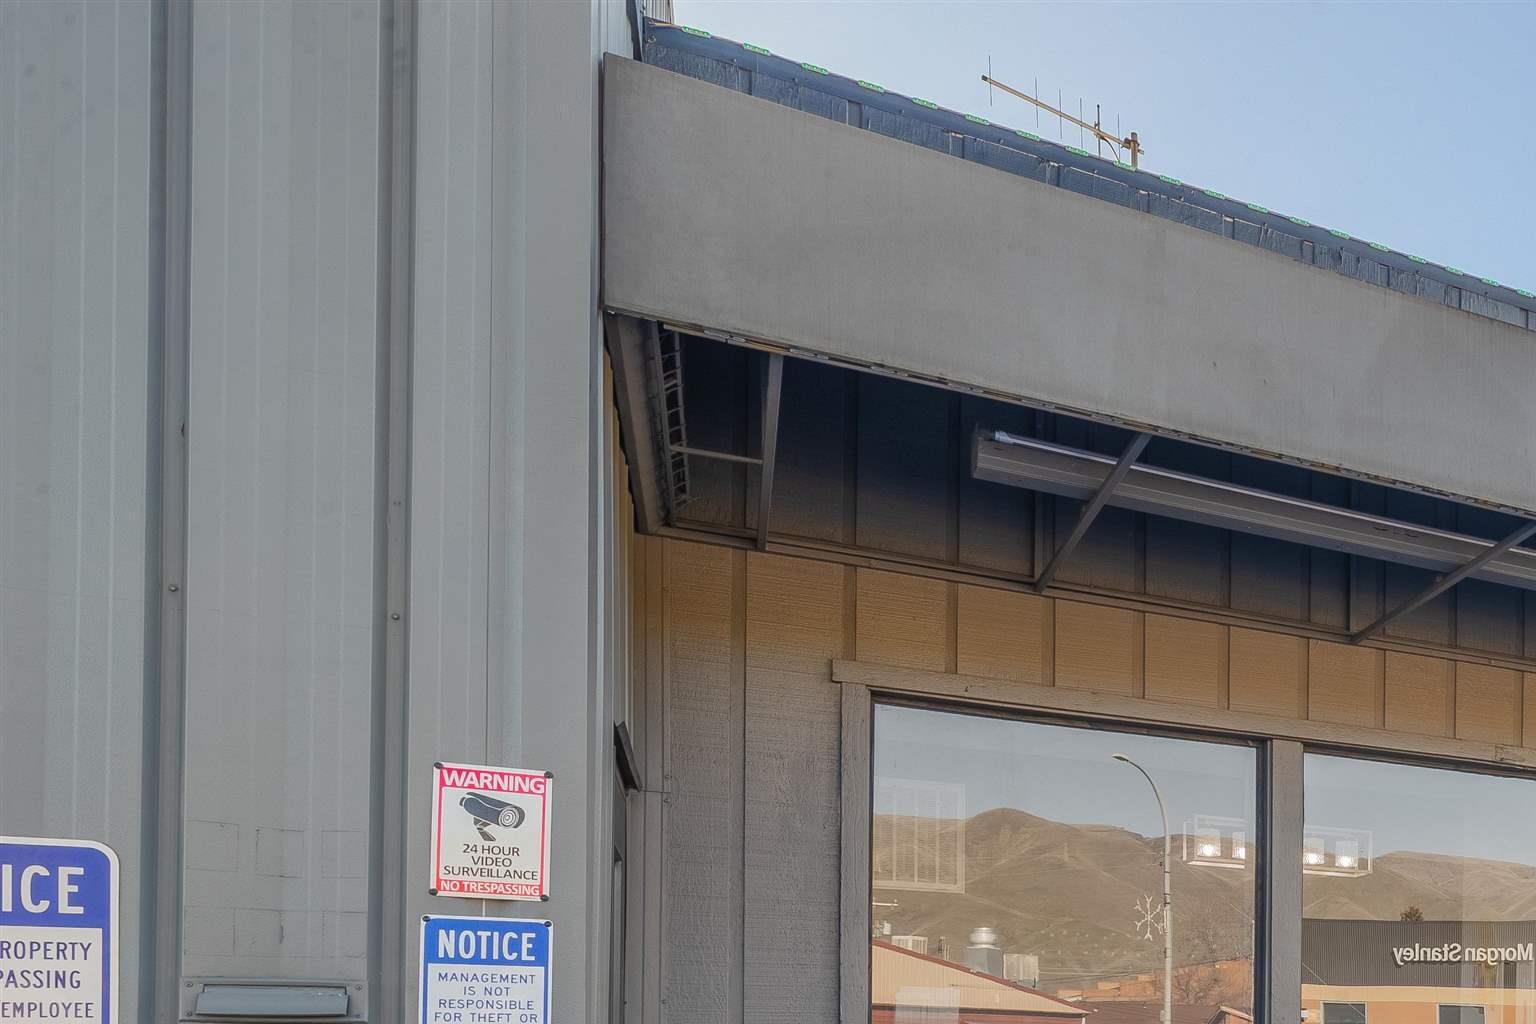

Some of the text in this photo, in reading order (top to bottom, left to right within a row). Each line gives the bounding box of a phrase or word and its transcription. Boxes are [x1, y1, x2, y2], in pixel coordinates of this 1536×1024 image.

[442, 769, 545, 793] WARNING
[463, 843, 520, 856] 24 HOUR
[471, 856, 512, 867] VIDEO
[443, 865, 538, 880] SURVEILLANCE
[440, 880, 540, 895] NO TRESPASSING
[438, 929, 536, 961] NOTICE
[438, 972, 536, 984] MANAGEMENT
[463, 986, 511, 996] IS NOT
[1, 1001, 94, 1018] EMPLOYEE
[438, 999, 534, 1010] RESPONSIBLE
[434, 1012, 538, 1023] FOR THEFT OR
